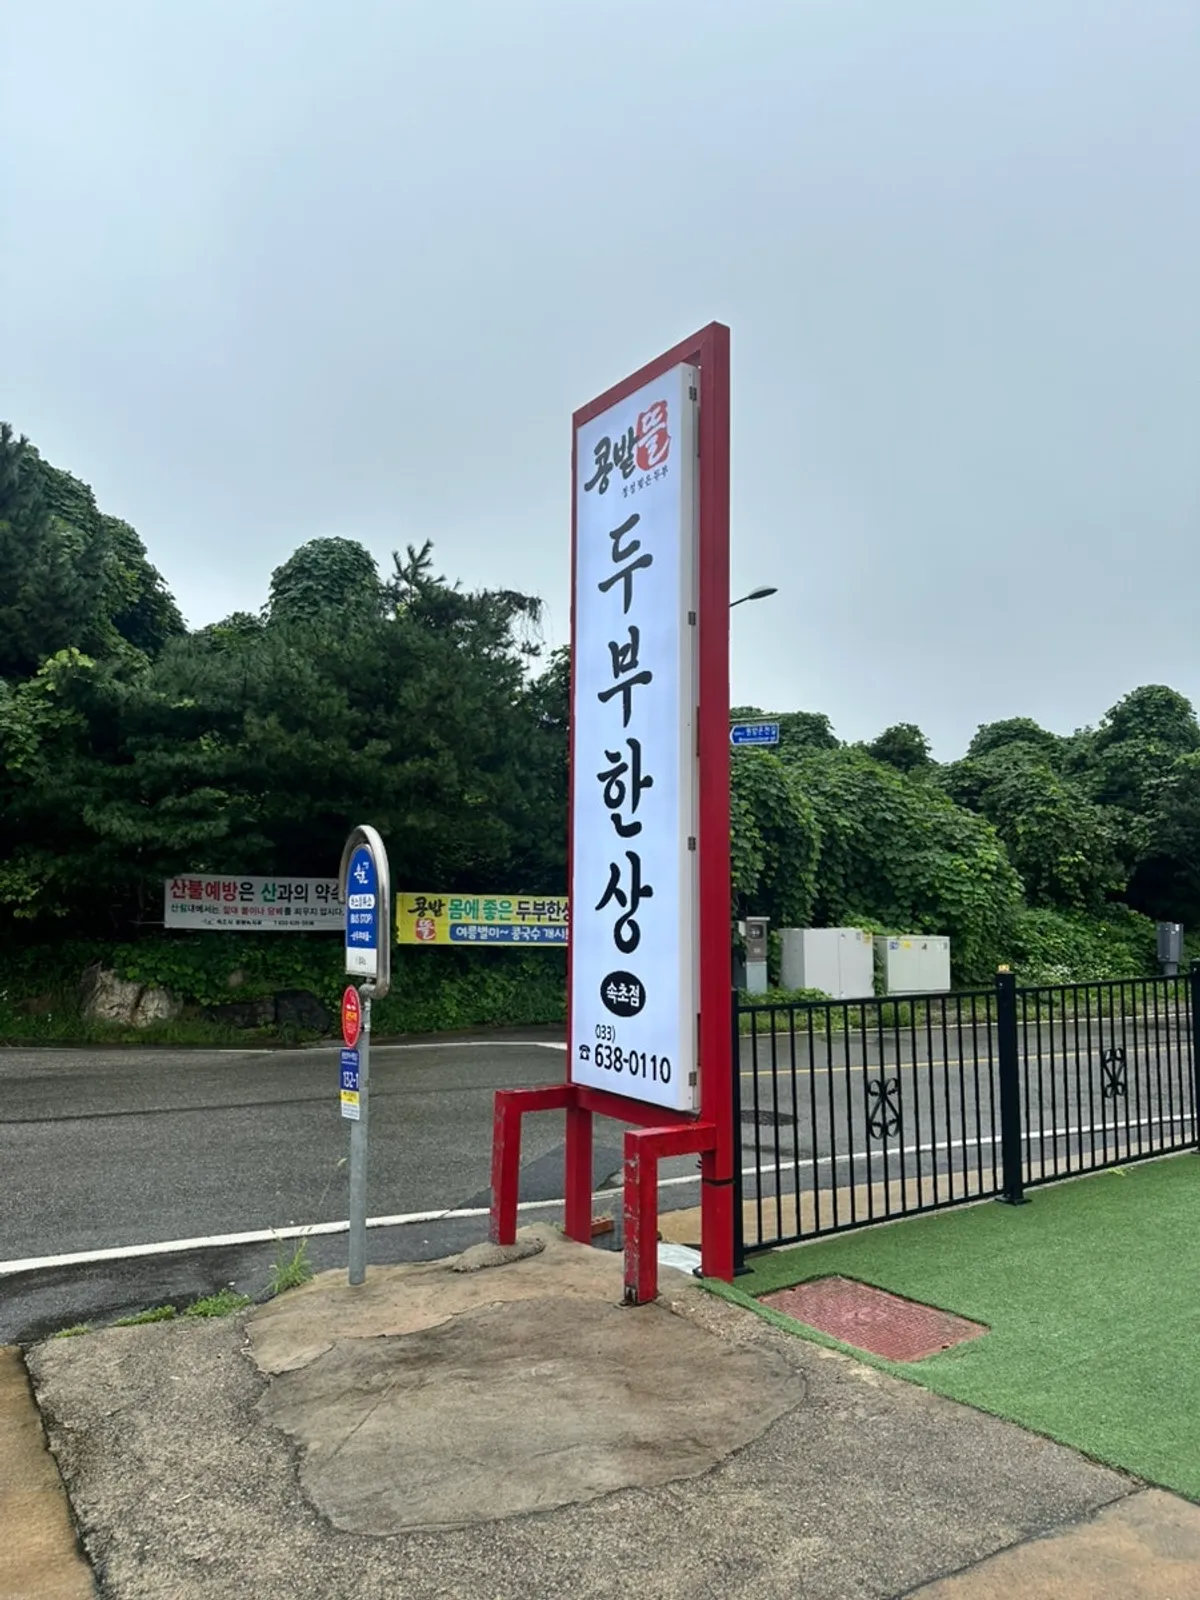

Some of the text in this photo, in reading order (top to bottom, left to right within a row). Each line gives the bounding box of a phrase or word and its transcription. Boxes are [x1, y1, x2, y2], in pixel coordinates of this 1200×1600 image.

[170, 879, 255, 902] 산불예방은
[261, 883, 308, 903] 산과의
[449, 899, 479, 920] 몸에
[483, 900, 513, 921] 좋은
[512, 927, 541, 941] 콩국수
[606, 982, 640, 1007] 속초점
[595, 1043, 671, 1084] 638-0110
